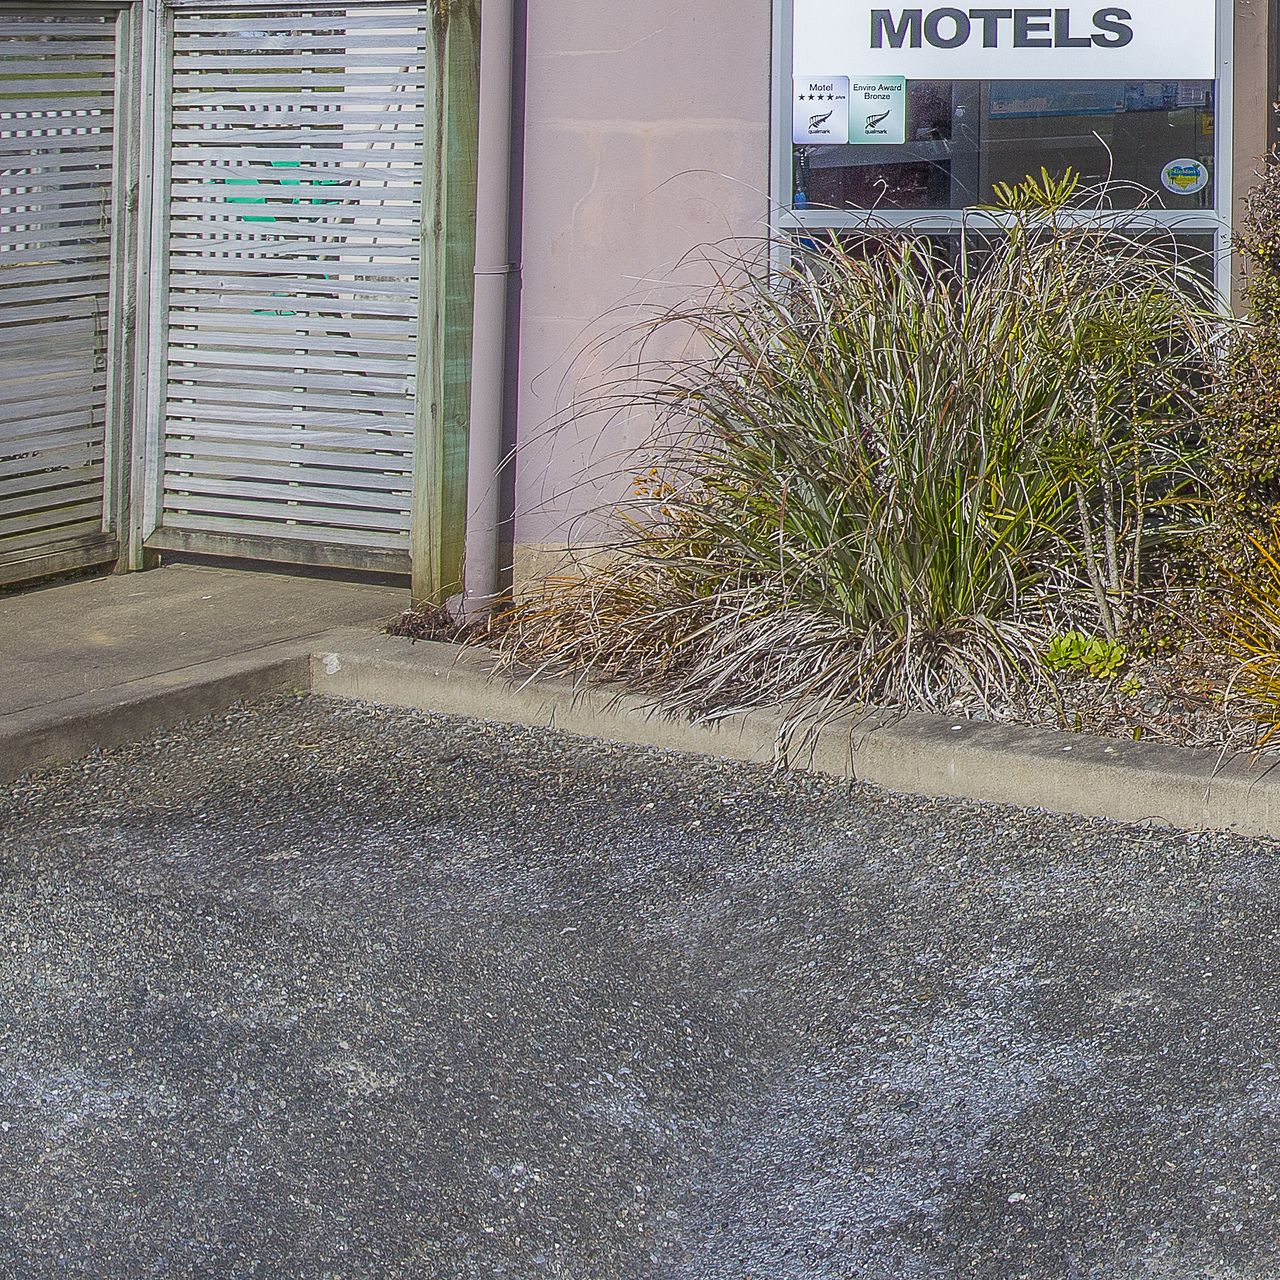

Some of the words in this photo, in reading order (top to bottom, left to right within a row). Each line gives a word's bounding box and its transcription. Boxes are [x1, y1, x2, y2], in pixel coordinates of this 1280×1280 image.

[869, 7, 1134, 49] MOTELS
[809, 83, 833, 92] Motel
[853, 83, 877, 92] Enviro
[877, 83, 902, 92] Award
[864, 92, 891, 100] Bronze
